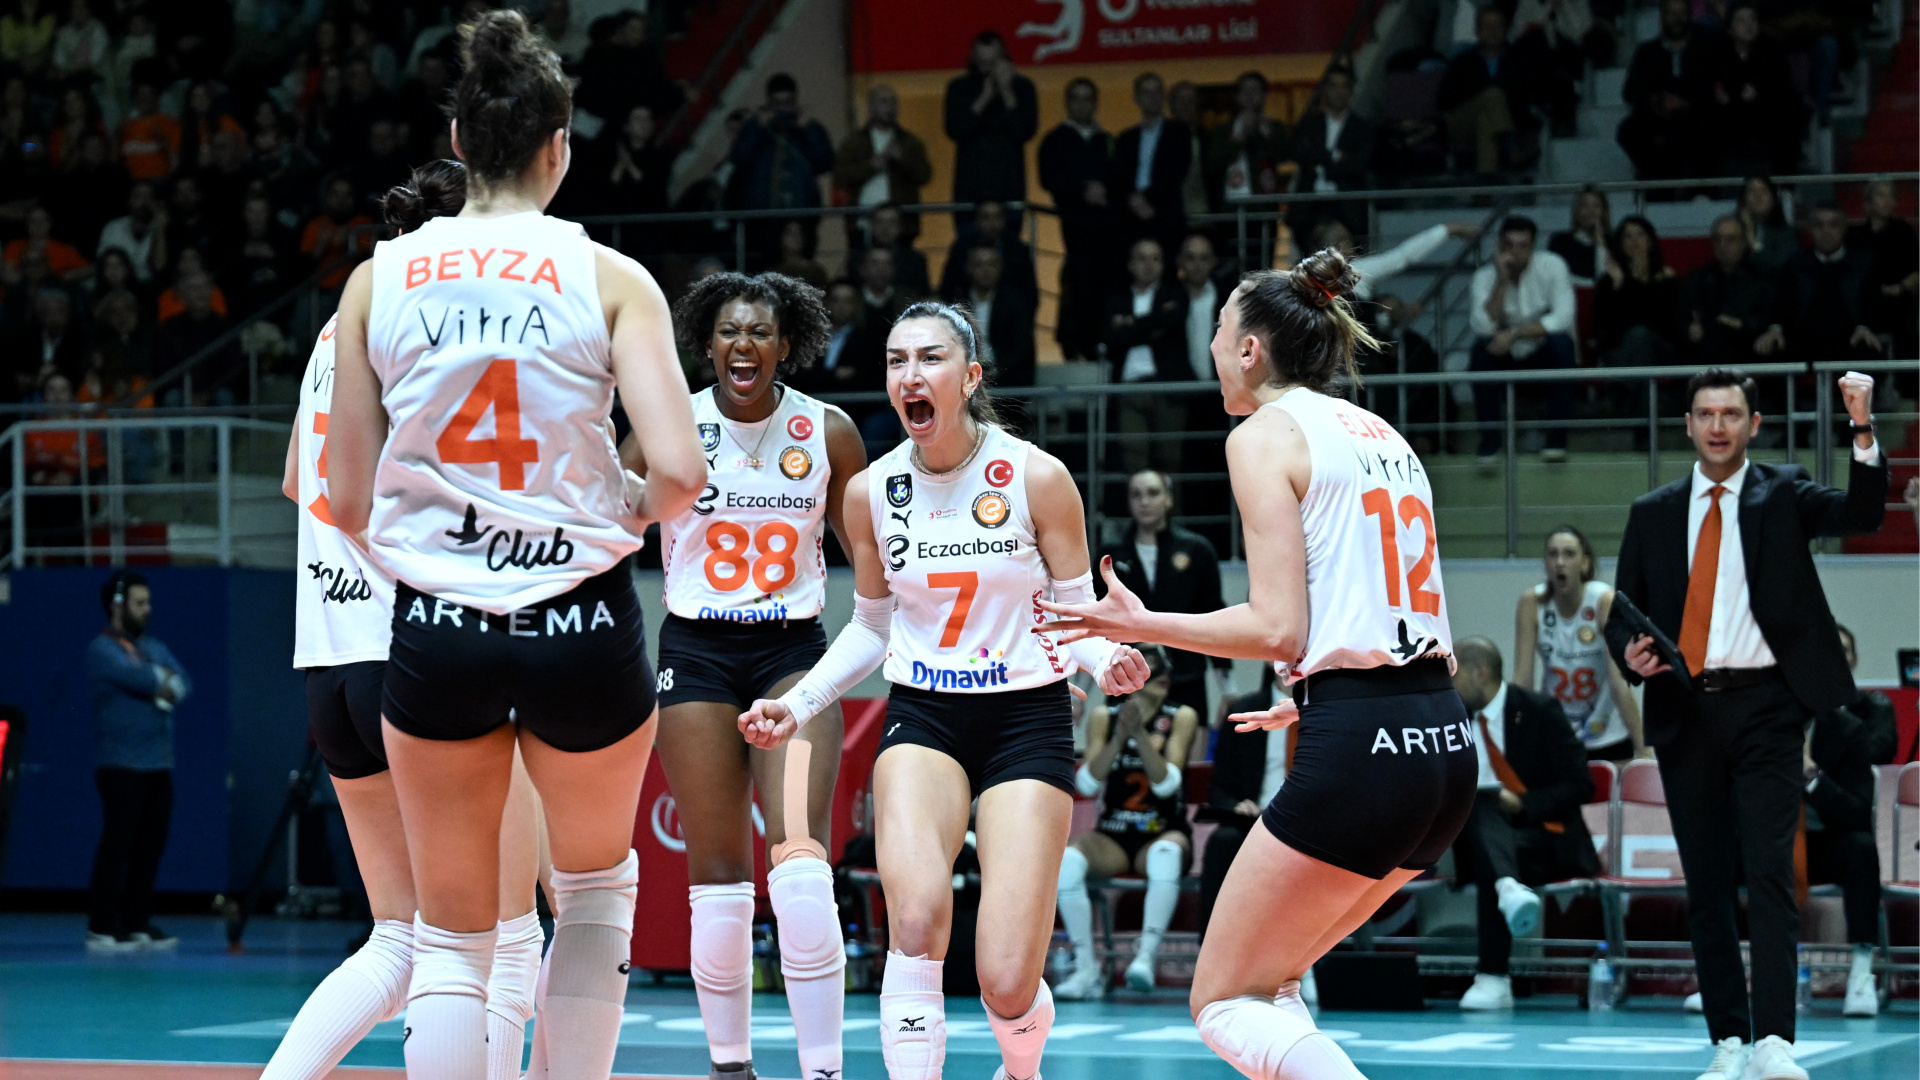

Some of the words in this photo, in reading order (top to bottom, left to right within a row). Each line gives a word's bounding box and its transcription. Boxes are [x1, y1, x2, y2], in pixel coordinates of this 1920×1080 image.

[405, 248, 562, 294] BEYZA
[419, 305, 550, 346] VitrA
[436, 358, 539, 491] 4
[726, 492, 816, 512] Eczacıbaşı
[487, 527, 574, 572] Club
[703, 521, 799, 593] 88
[918, 538, 1018, 559] Eczacıbaşı
[1361, 487, 1441, 618] 12
[320, 567, 372, 603] Club
[927, 571, 979, 648] 7
[1032, 589, 1064, 674] PEGSUS
[911, 660, 1009, 692] Dynavit
[1549, 666, 1597, 702] 28
[1123, 772, 1151, 811] 2
